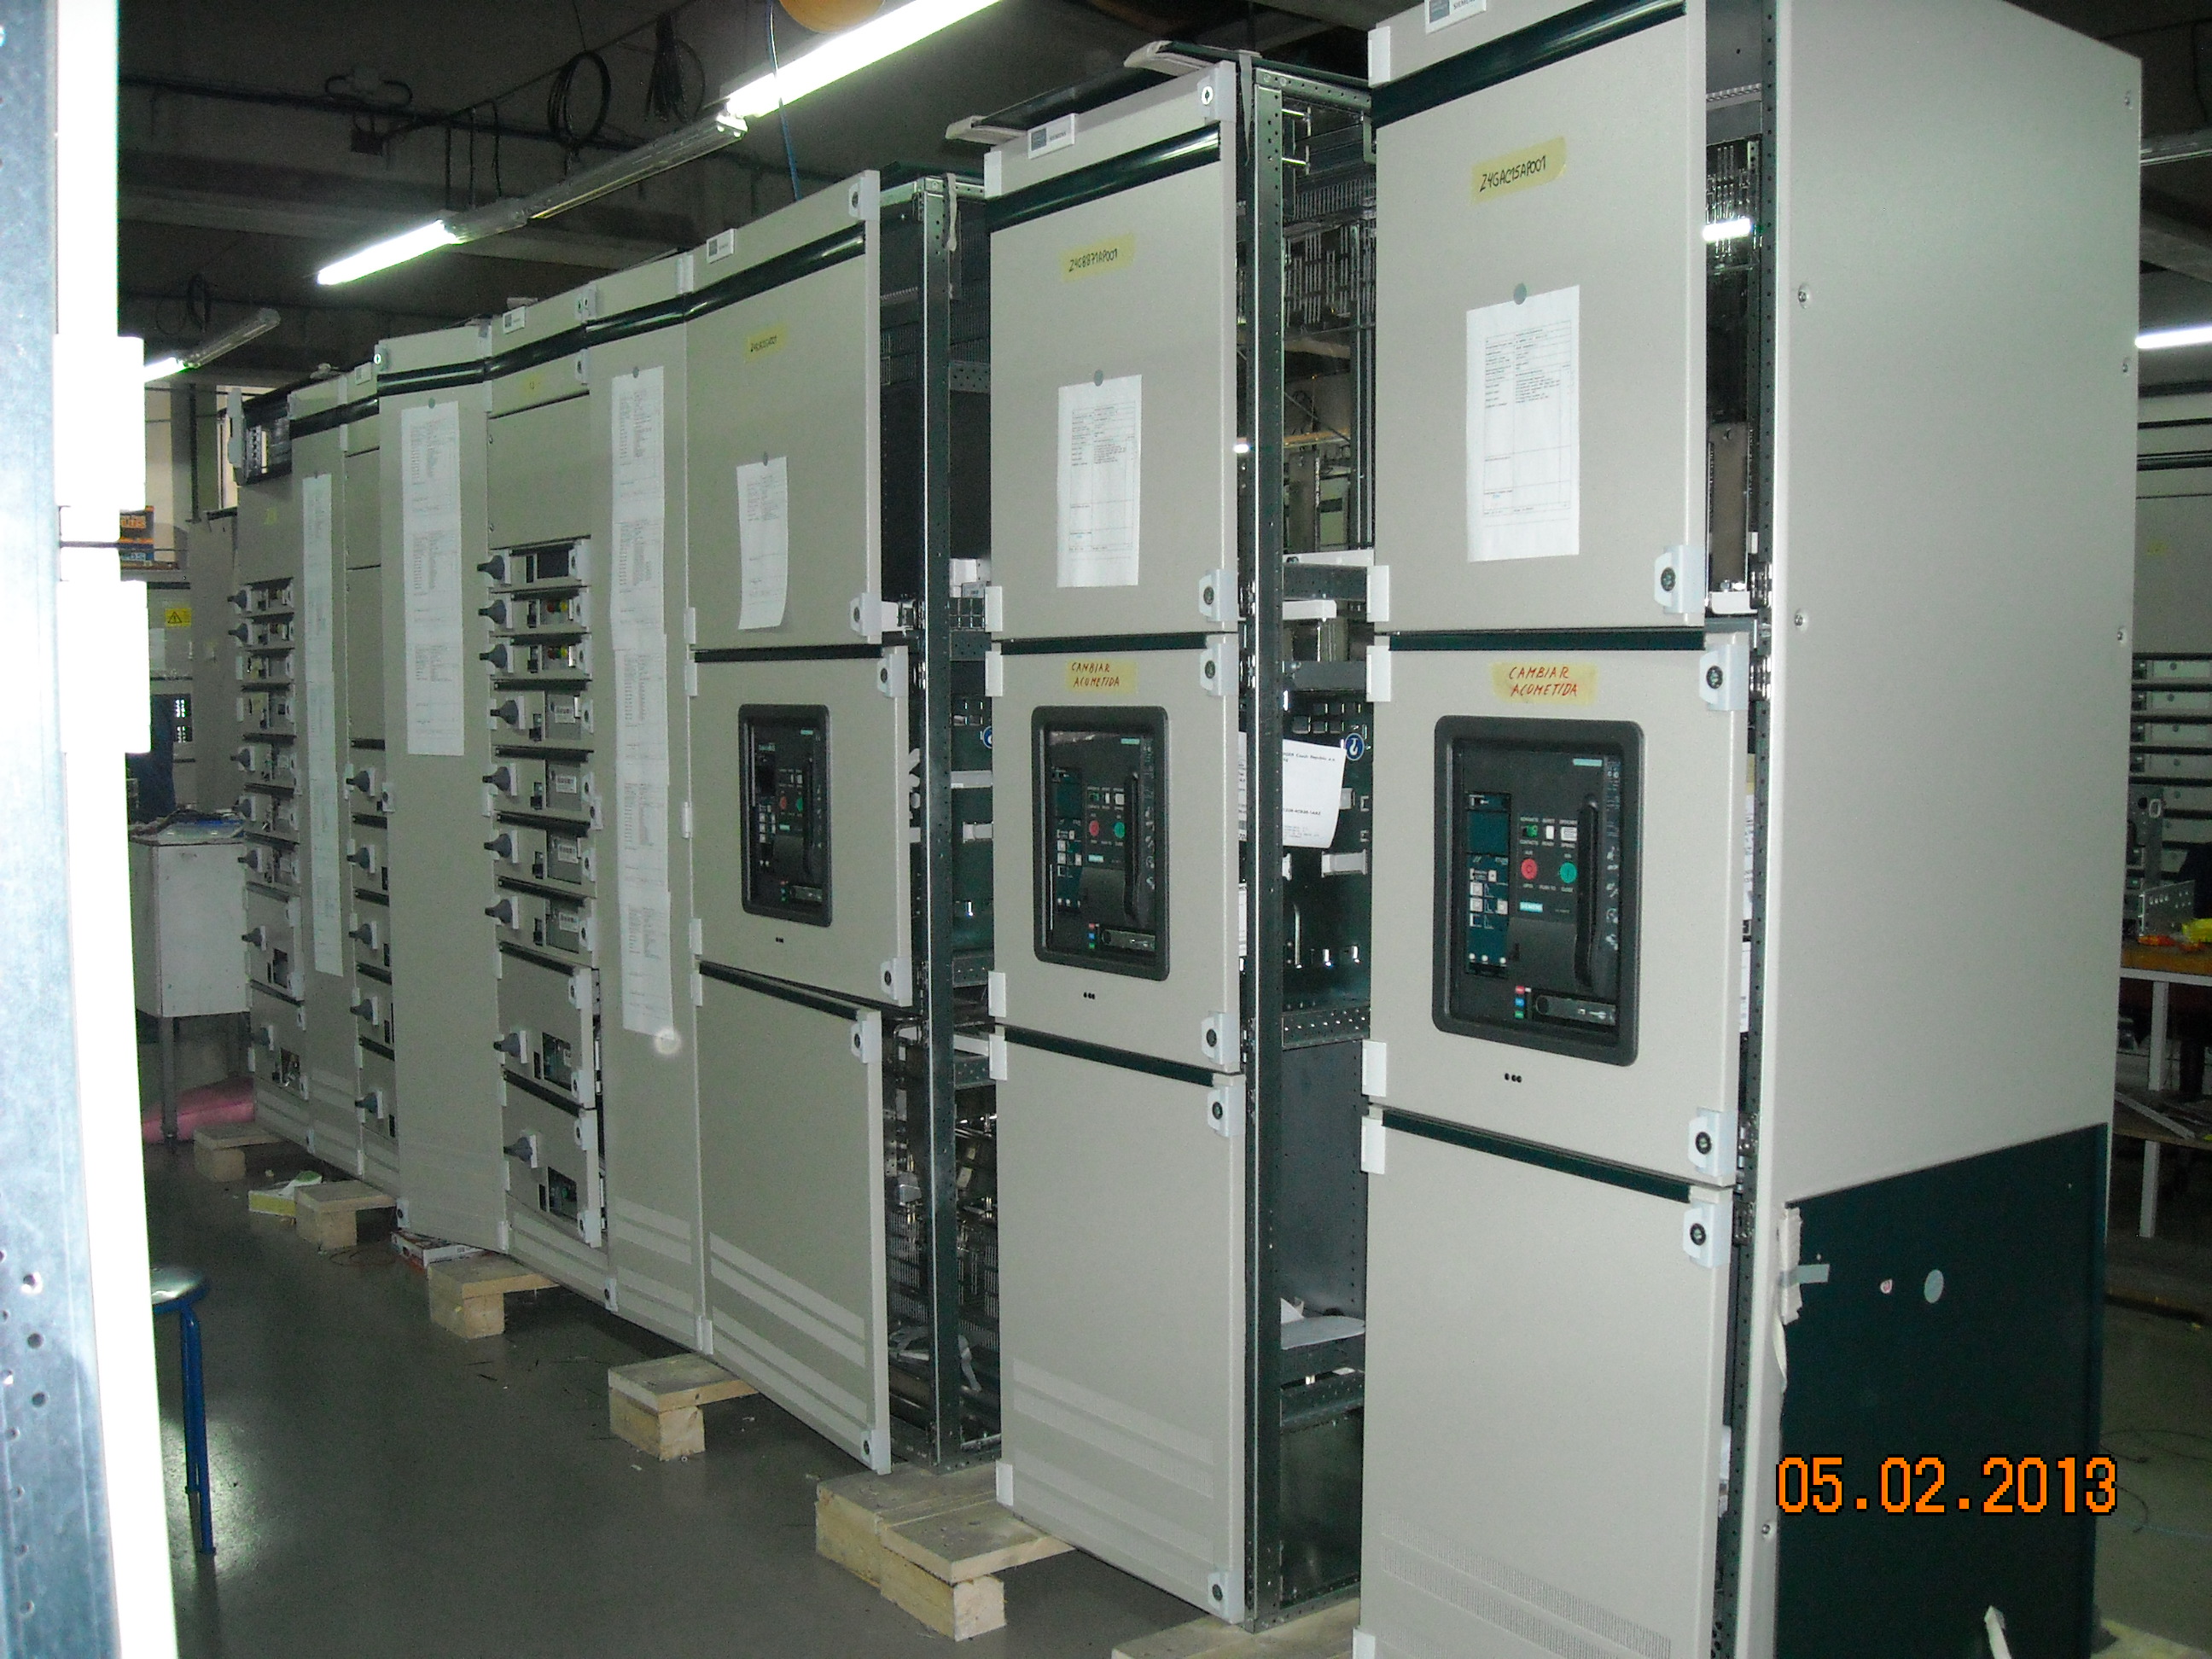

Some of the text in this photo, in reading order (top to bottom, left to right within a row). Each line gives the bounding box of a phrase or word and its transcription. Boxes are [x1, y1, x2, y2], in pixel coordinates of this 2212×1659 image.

[1071, 662, 1110, 673] CAMBIAR
[1509, 666, 1569, 679] CAMBIAR
[1073, 676, 1121, 688] ACOMETIDA
[1511, 683, 1578, 697] ACOMETIDA
